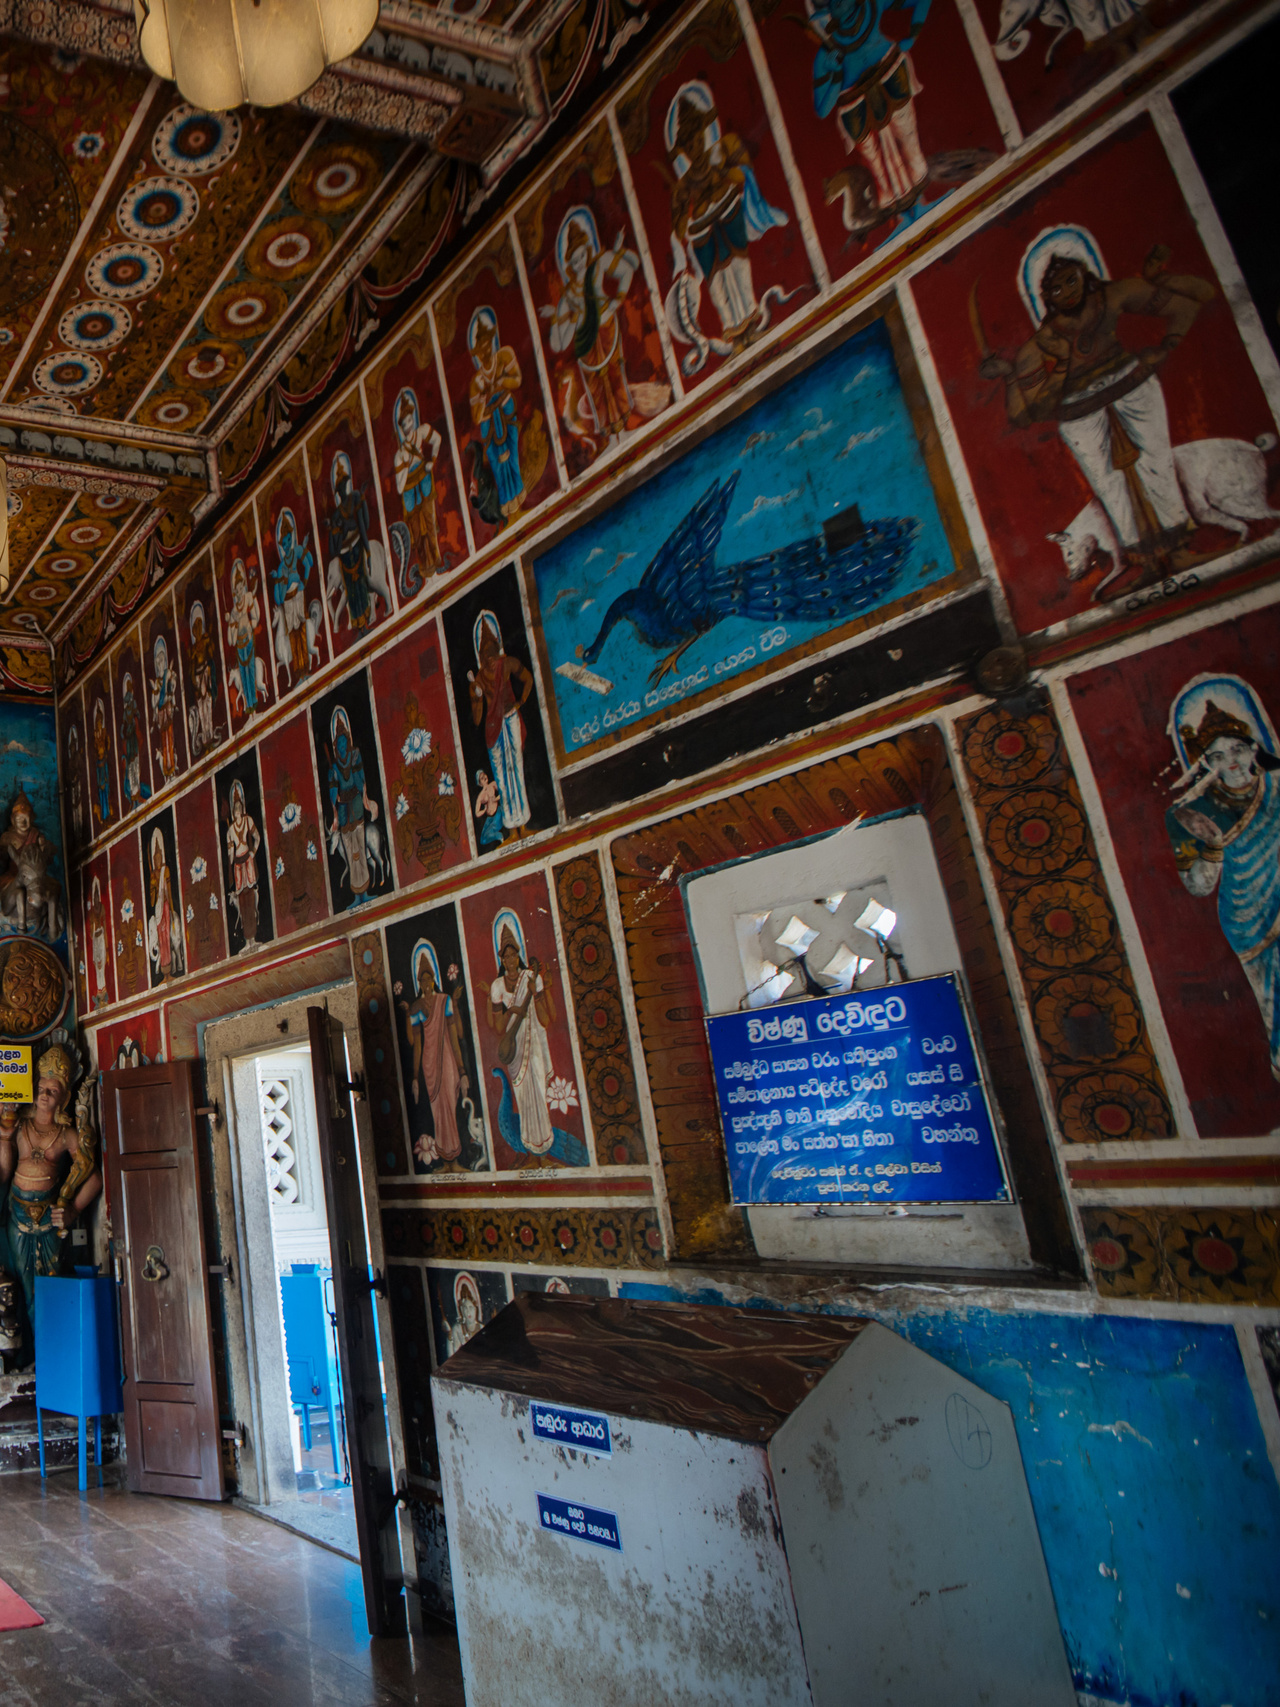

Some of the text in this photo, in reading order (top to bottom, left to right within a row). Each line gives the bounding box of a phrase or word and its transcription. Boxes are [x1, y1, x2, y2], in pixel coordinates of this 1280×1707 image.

[747, 996, 907, 1043] විෂ්ණු දෙවිඳුට
[812, 1051, 839, 1069] වරං
